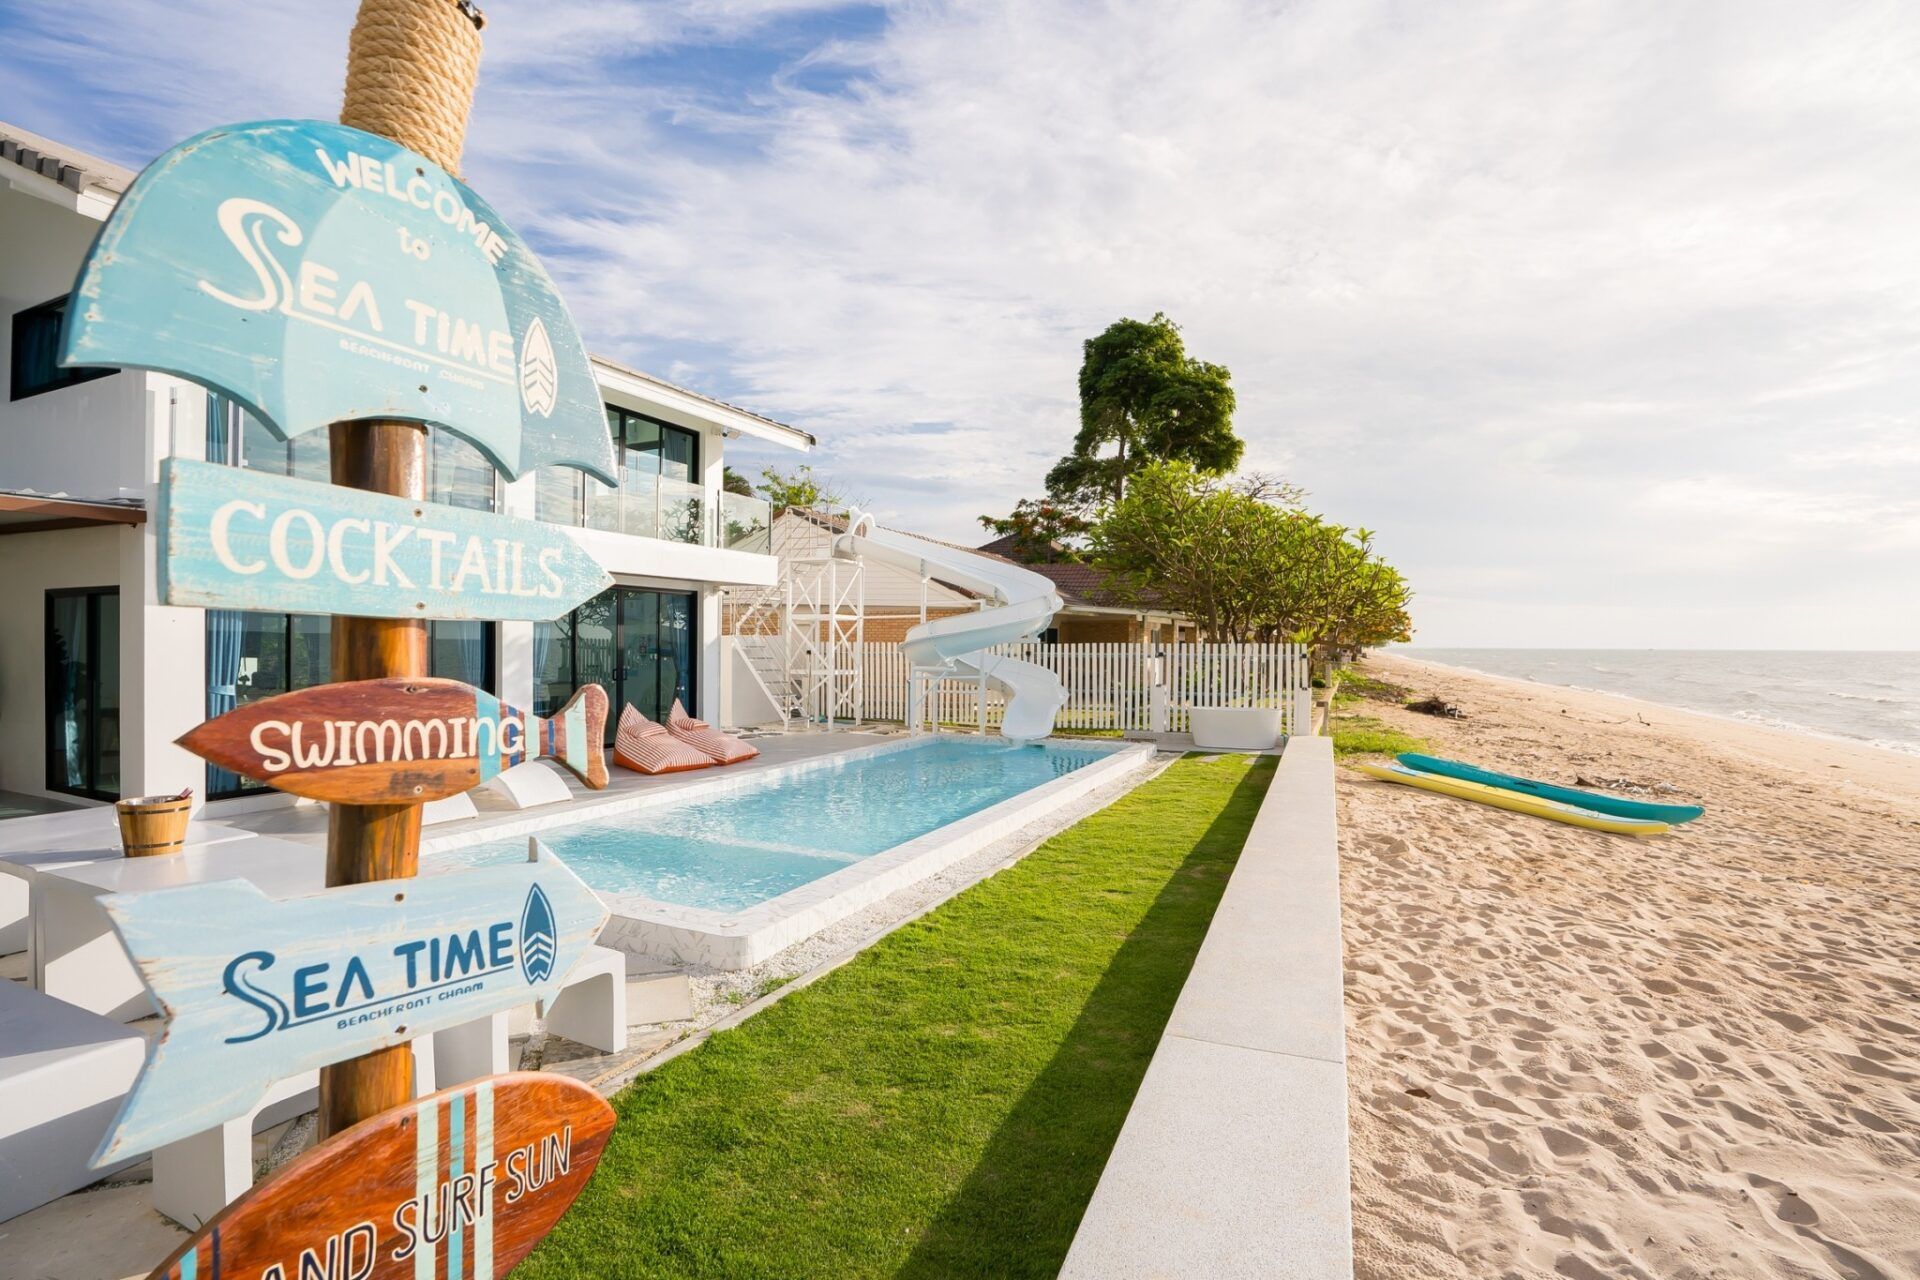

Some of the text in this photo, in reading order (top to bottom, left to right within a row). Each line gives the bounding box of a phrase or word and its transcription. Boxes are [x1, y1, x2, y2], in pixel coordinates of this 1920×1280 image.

[315, 148, 508, 266] WELCOME
[395, 226, 430, 261] to
[406, 299, 515, 376] TIME
[210, 500, 565, 599] COCKTAILS
[393, 922, 514, 989] TIME
[337, 981, 484, 1030] BEACHFRONT CHAAM
[391, 1160, 498, 1261] SURF
[505, 1125, 571, 1203] SUN
